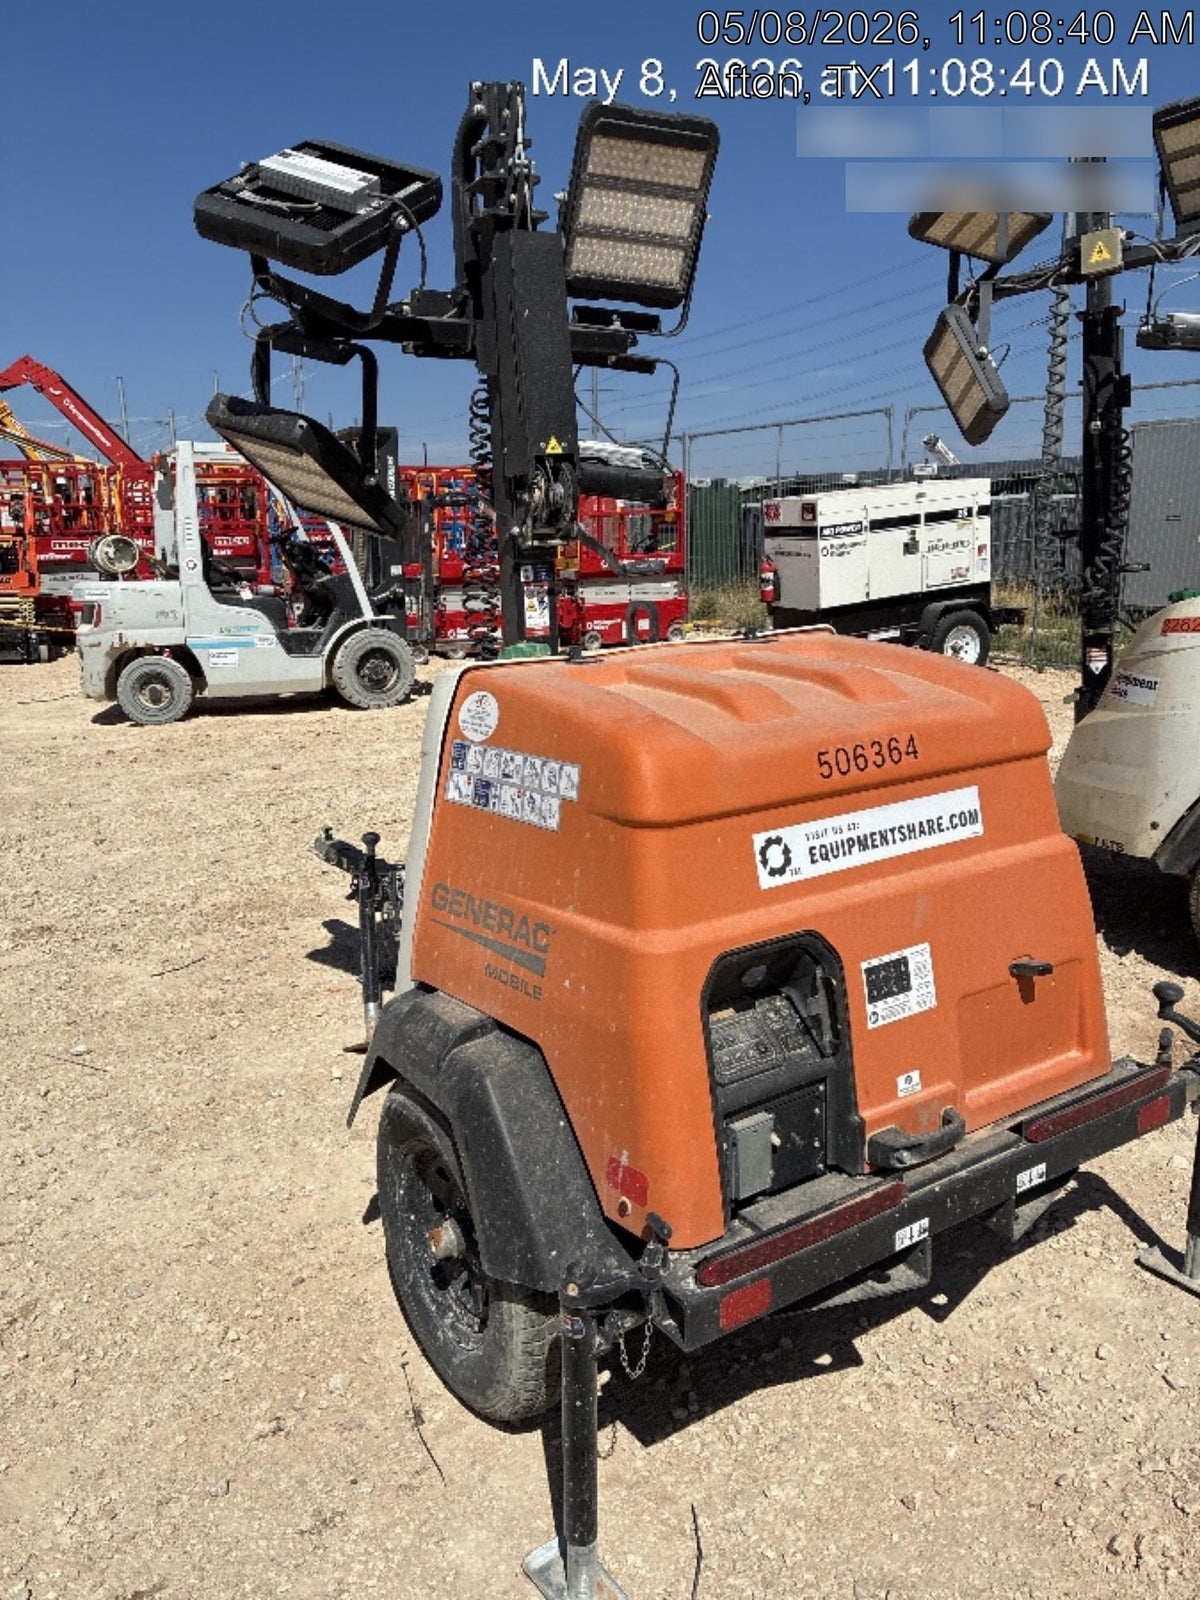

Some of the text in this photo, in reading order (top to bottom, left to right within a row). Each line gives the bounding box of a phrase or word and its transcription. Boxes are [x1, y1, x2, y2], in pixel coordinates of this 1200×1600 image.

[817, 734, 919, 779] 506364
[804, 822, 860, 842] VISIT US AT:
[808, 808, 979, 865] EQUIPMENTSHARE.COM
[431, 882, 552, 954] GENERAC
[484, 962, 543, 1001] MOBILE
